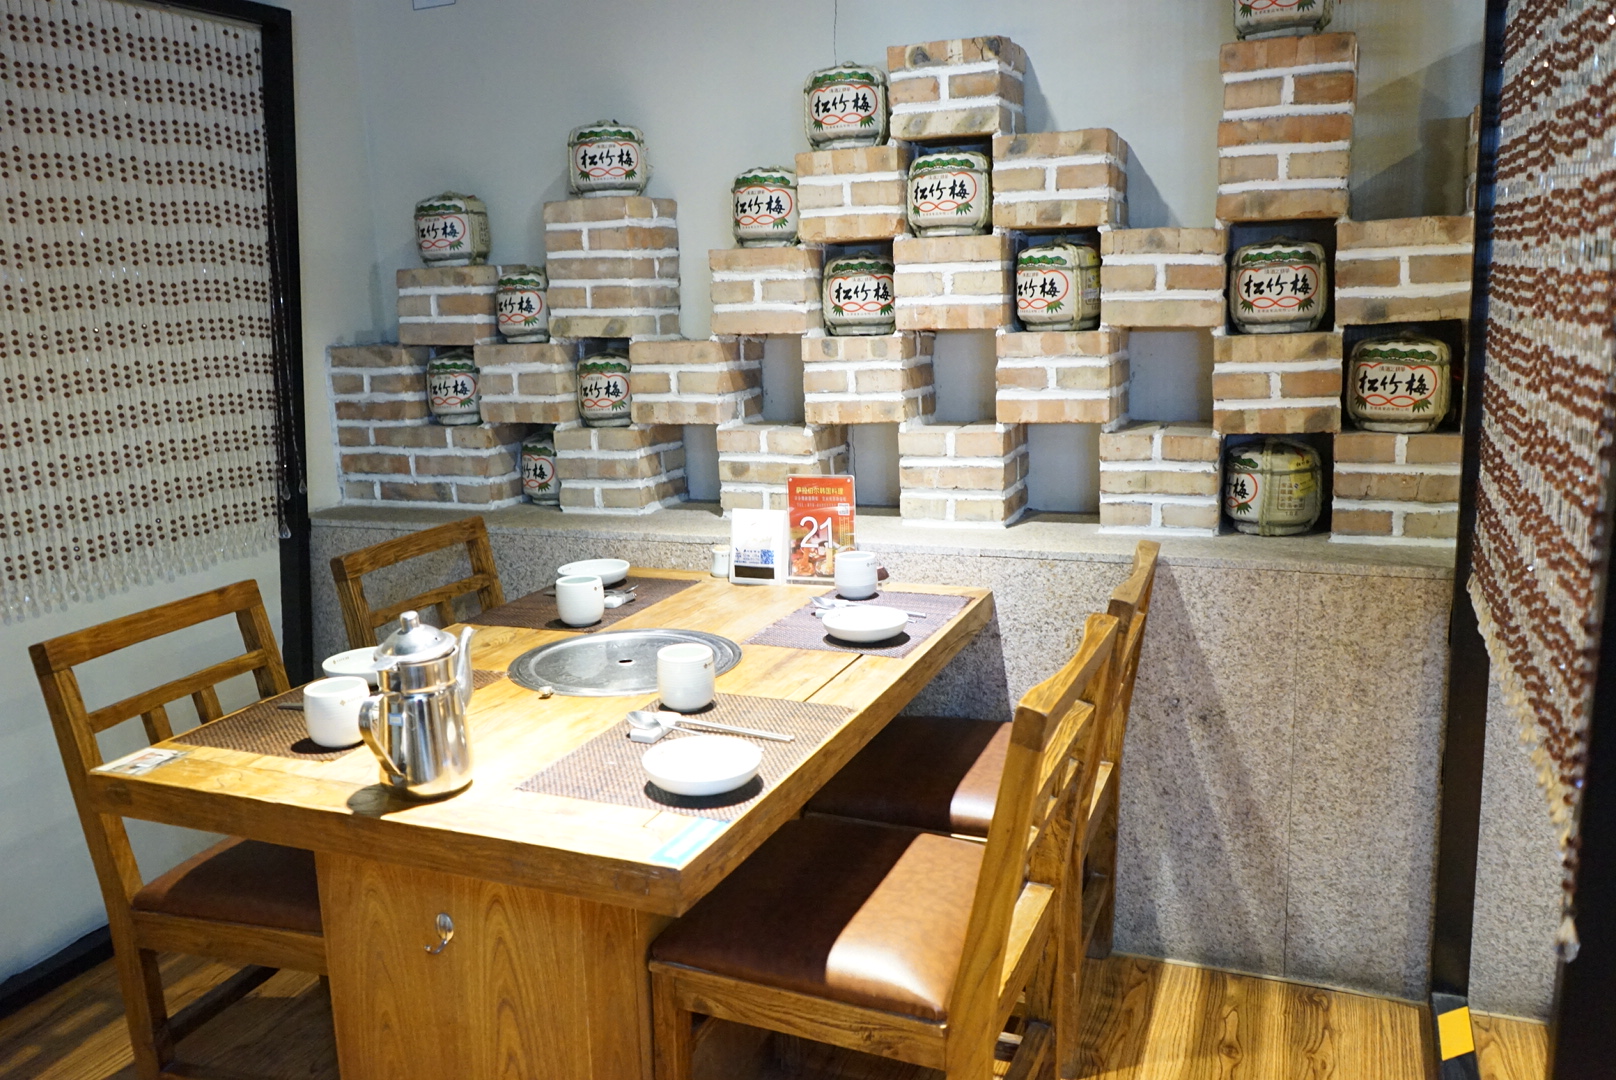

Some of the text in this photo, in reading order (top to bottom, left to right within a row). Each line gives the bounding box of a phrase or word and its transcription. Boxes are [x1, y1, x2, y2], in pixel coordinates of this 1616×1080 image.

[814, 92, 872, 117] 松竹梅
[580, 148, 635, 169] 松竹梅
[914, 179, 970, 203] 松竹梅
[735, 195, 786, 217] 松竹梅
[834, 282, 892, 303] 松竹梅
[1244, 273, 1312, 298] 松竹梅
[1359, 370, 1430, 396] 松竹梅
[799, 516, 833, 549] 21
